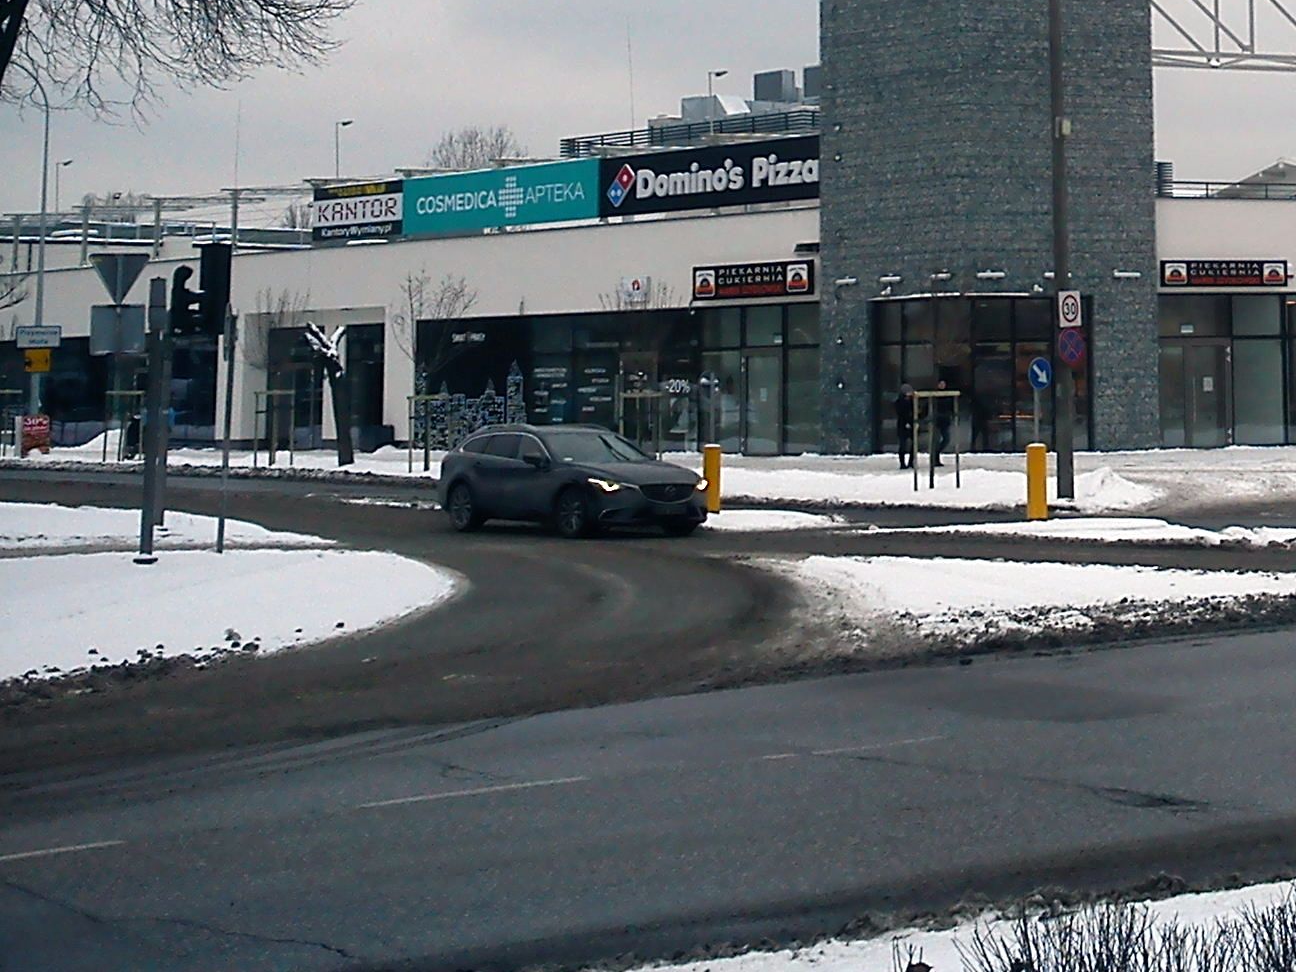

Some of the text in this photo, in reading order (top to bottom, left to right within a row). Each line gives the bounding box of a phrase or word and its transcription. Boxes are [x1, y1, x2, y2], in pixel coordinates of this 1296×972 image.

[635, 153, 819, 199] Domino's Pizza
[416, 181, 585, 215] COSMEDICA APTEKA
[317, 198, 398, 223] KANTOR
[718, 266, 783, 276] PIEKARNIA
[718, 273, 783, 285] CUKIERNIA
[1064, 302, 1076, 316] 30
